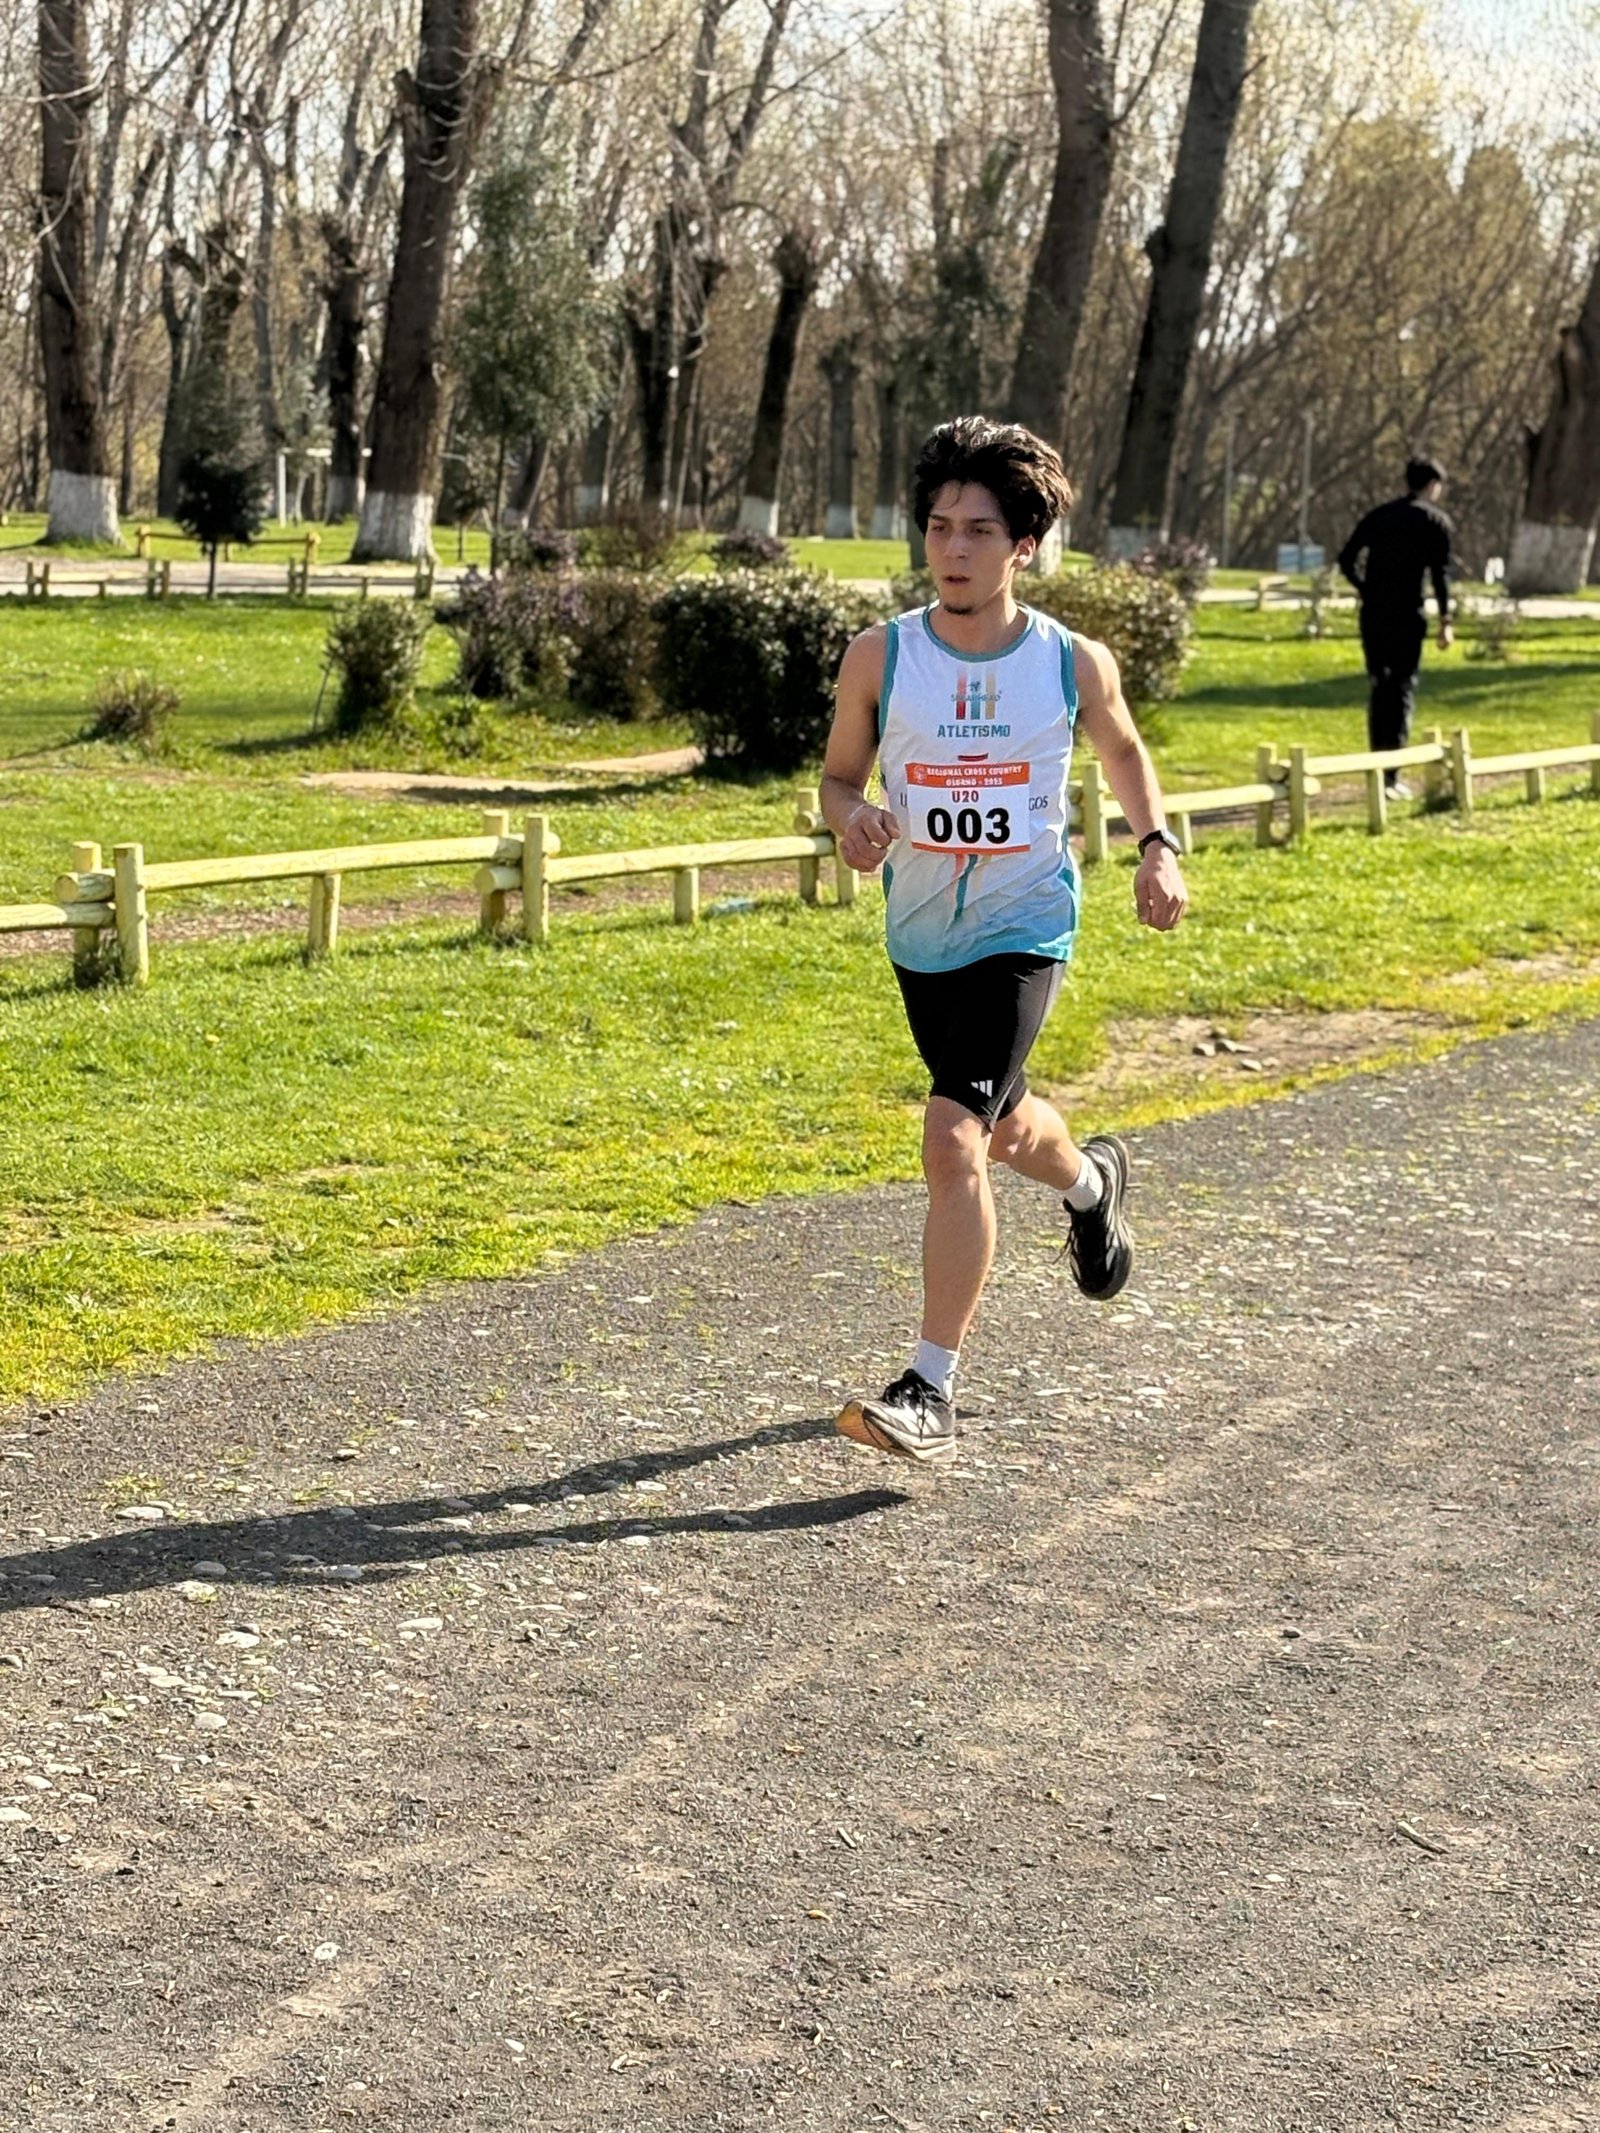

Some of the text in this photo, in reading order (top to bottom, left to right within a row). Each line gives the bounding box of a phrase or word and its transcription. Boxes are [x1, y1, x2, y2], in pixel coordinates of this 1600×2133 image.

[937, 724, 1011, 738] ATLETISMO
[927, 765, 1022, 776] REGIONAL CROSS COUNTRY
[951, 790, 979, 803] U20
[926, 807, 1011, 845] 003
